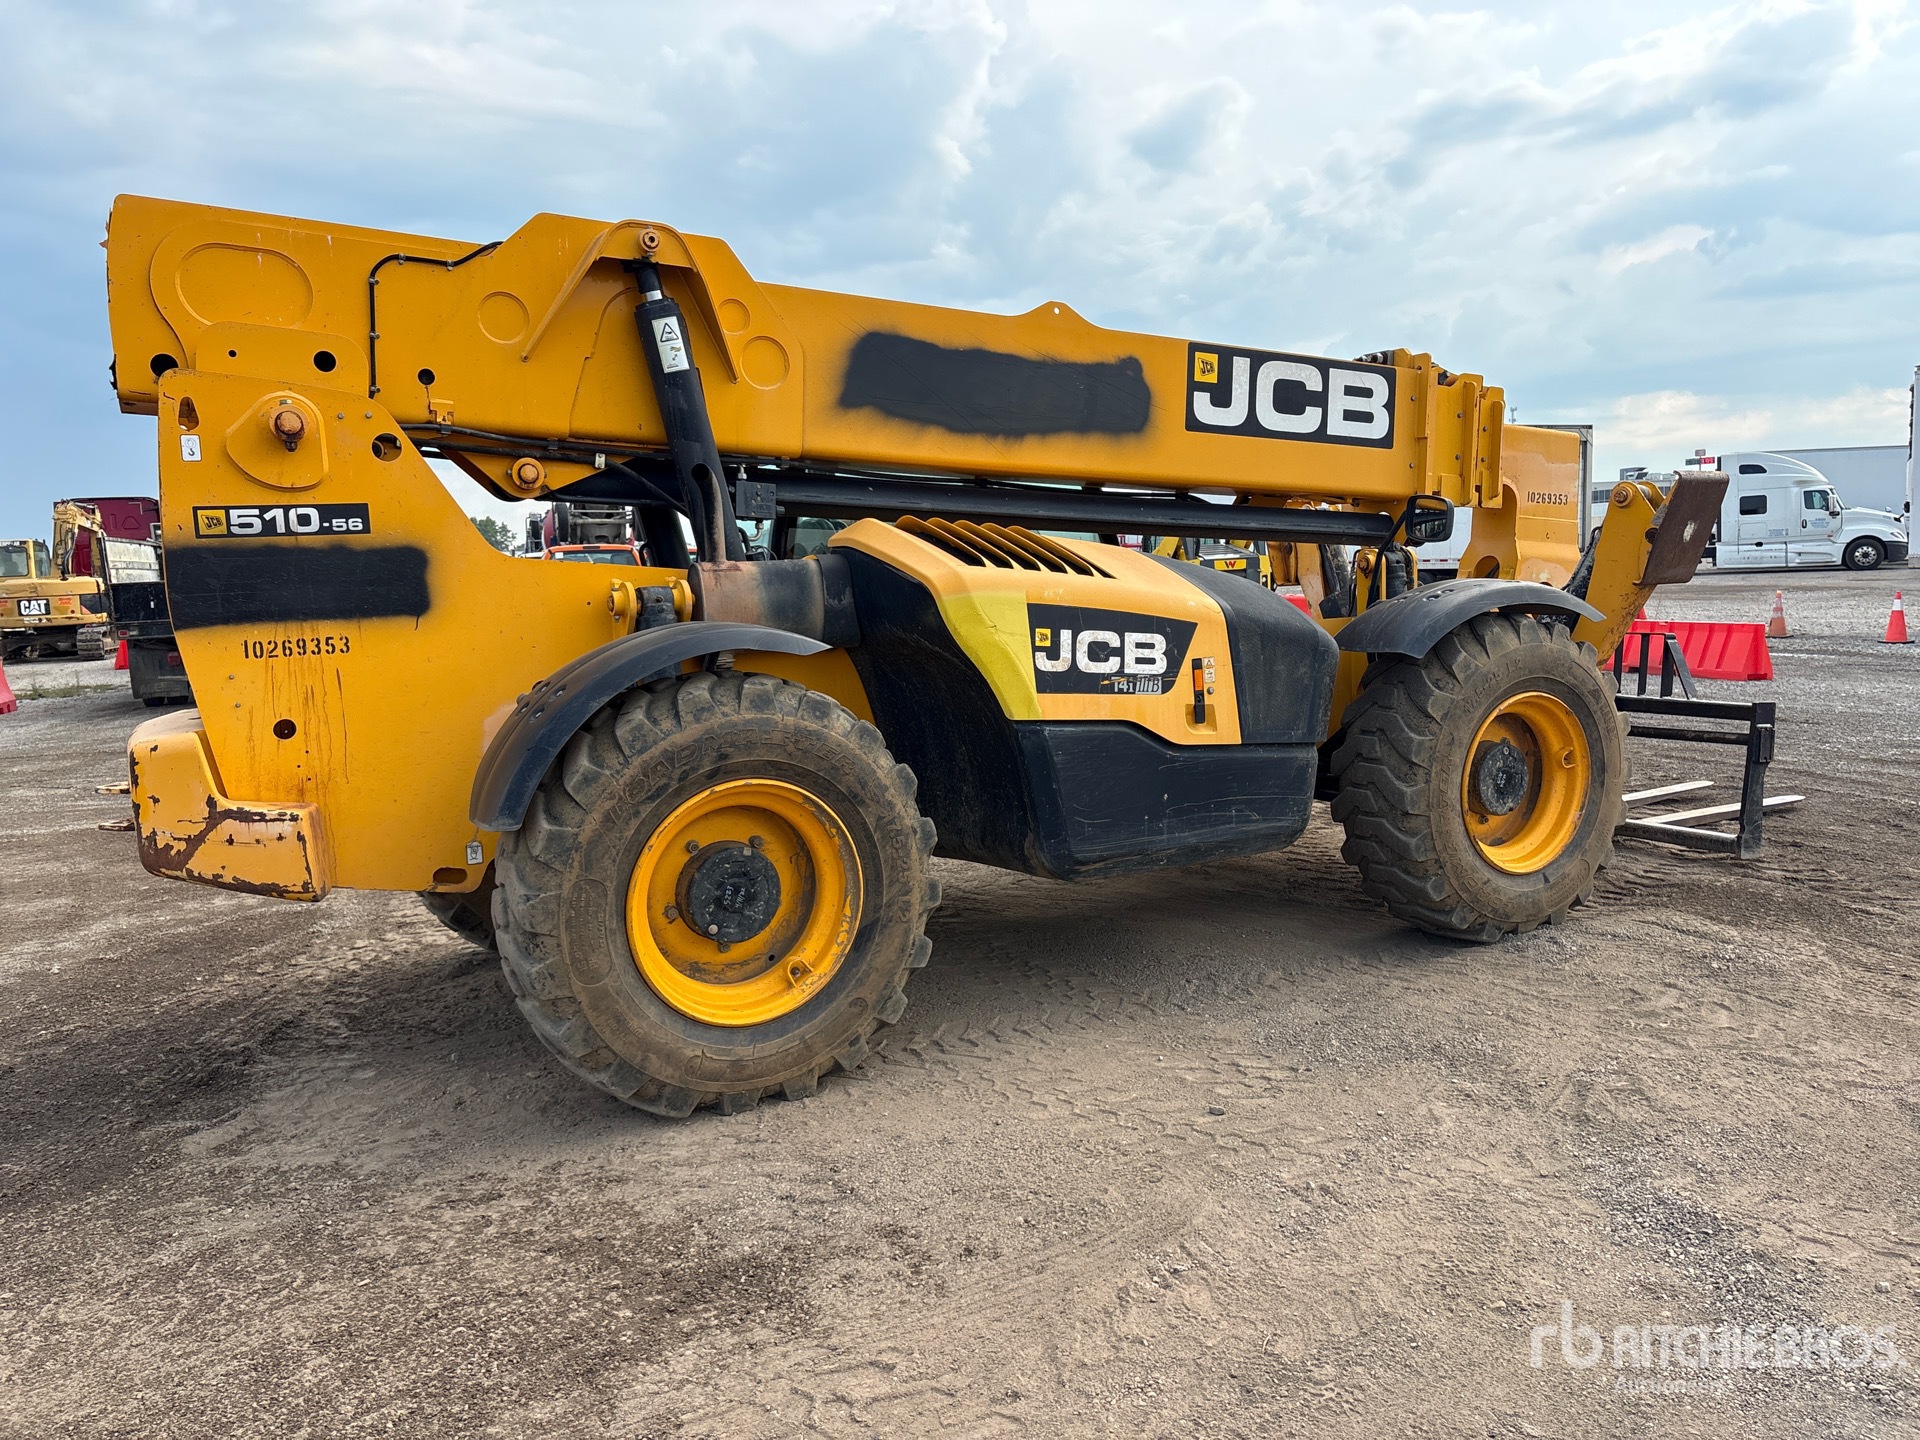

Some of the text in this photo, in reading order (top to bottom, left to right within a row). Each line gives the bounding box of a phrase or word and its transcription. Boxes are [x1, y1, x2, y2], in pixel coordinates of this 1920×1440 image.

[1193, 355, 1390, 440] JCB
[1527, 490, 1569, 506] 10269353
[205, 515, 223, 529] JCB
[19, 599, 48, 616] CAT
[241, 635, 351, 660] 10269353
[1034, 629, 1167, 675] JCB
